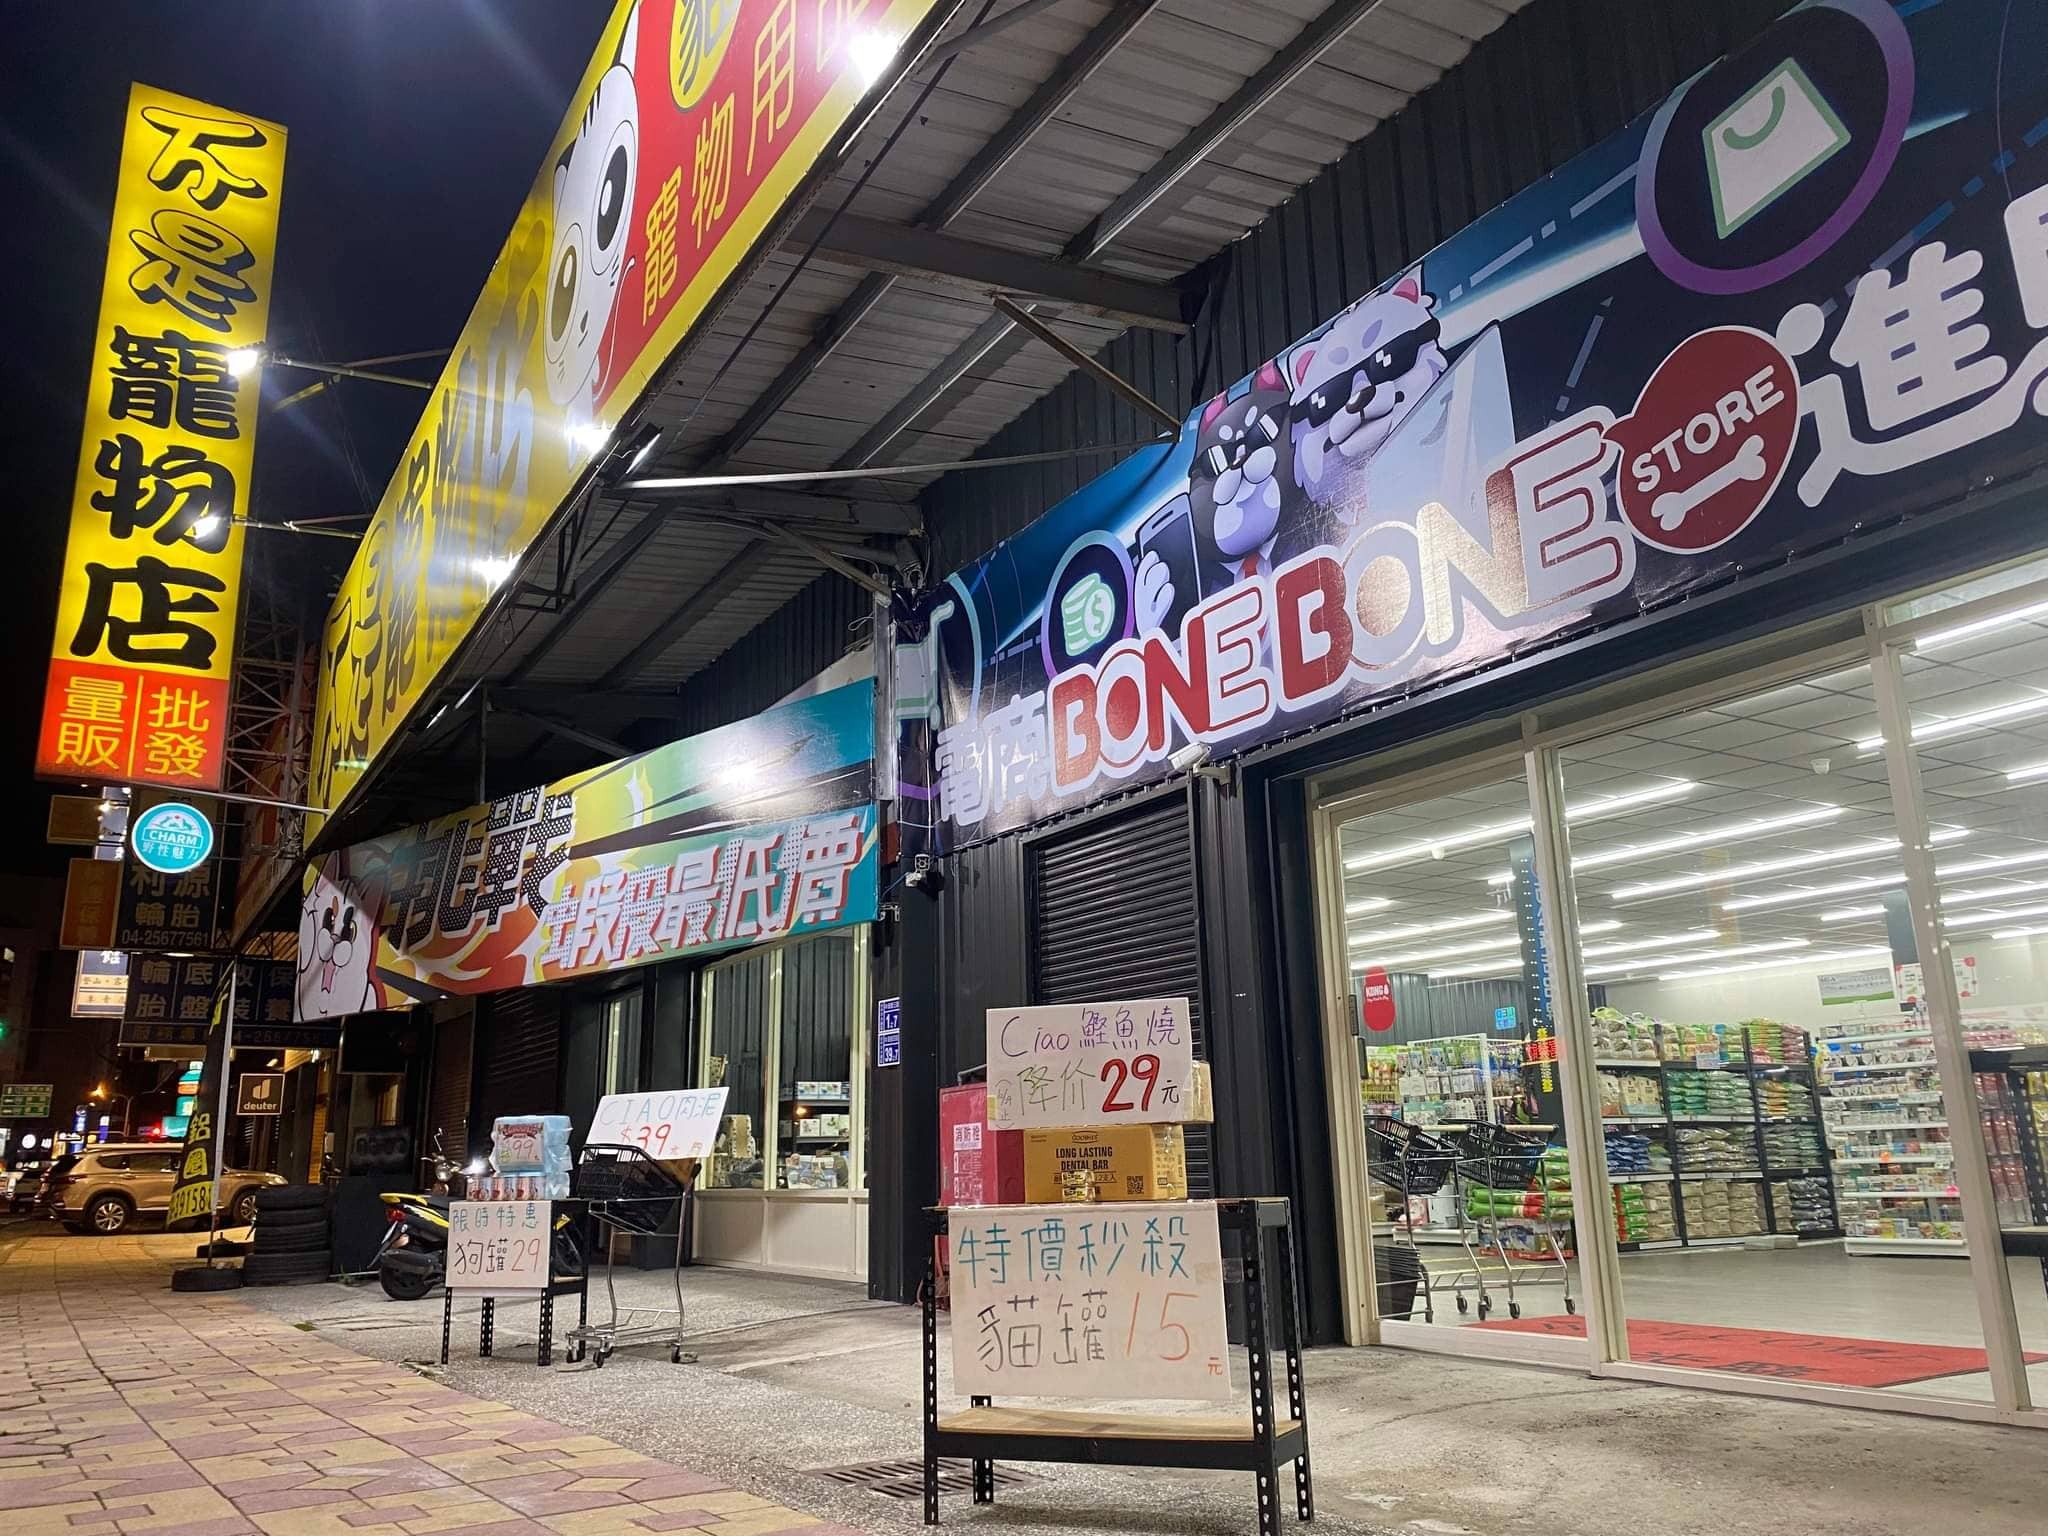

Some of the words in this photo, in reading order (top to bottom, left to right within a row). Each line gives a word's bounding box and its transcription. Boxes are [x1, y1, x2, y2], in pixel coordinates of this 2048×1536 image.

[1632, 366, 1785, 492] STORE
[1776, 184, 2048, 508] 進
[56, 676, 128, 770] 量販
[144, 686, 209, 778] 批發
[142, 842, 200, 860] 野性魅力
[149, 830, 198, 847] CHARM
[389, 787, 573, 950] 挑戰
[135, 902, 201, 928] 輪胎
[136, 960, 172, 1019] 輪胎
[180, 961, 214, 1020] 底盤
[243, 1100, 278, 1111] deuter
[1056, 1148, 1077, 1159] LONG
[1079, 1147, 1113, 1158] LASTING
[1061, 1160, 1090, 1170] DENTAL
[1093, 1159, 1109, 1170] BAR
[451, 1202, 540, 1233] 限時特惠
[453, 1237, 542, 1275] 狗罐29
[957, 1215, 1190, 1289] 特價秒殺
